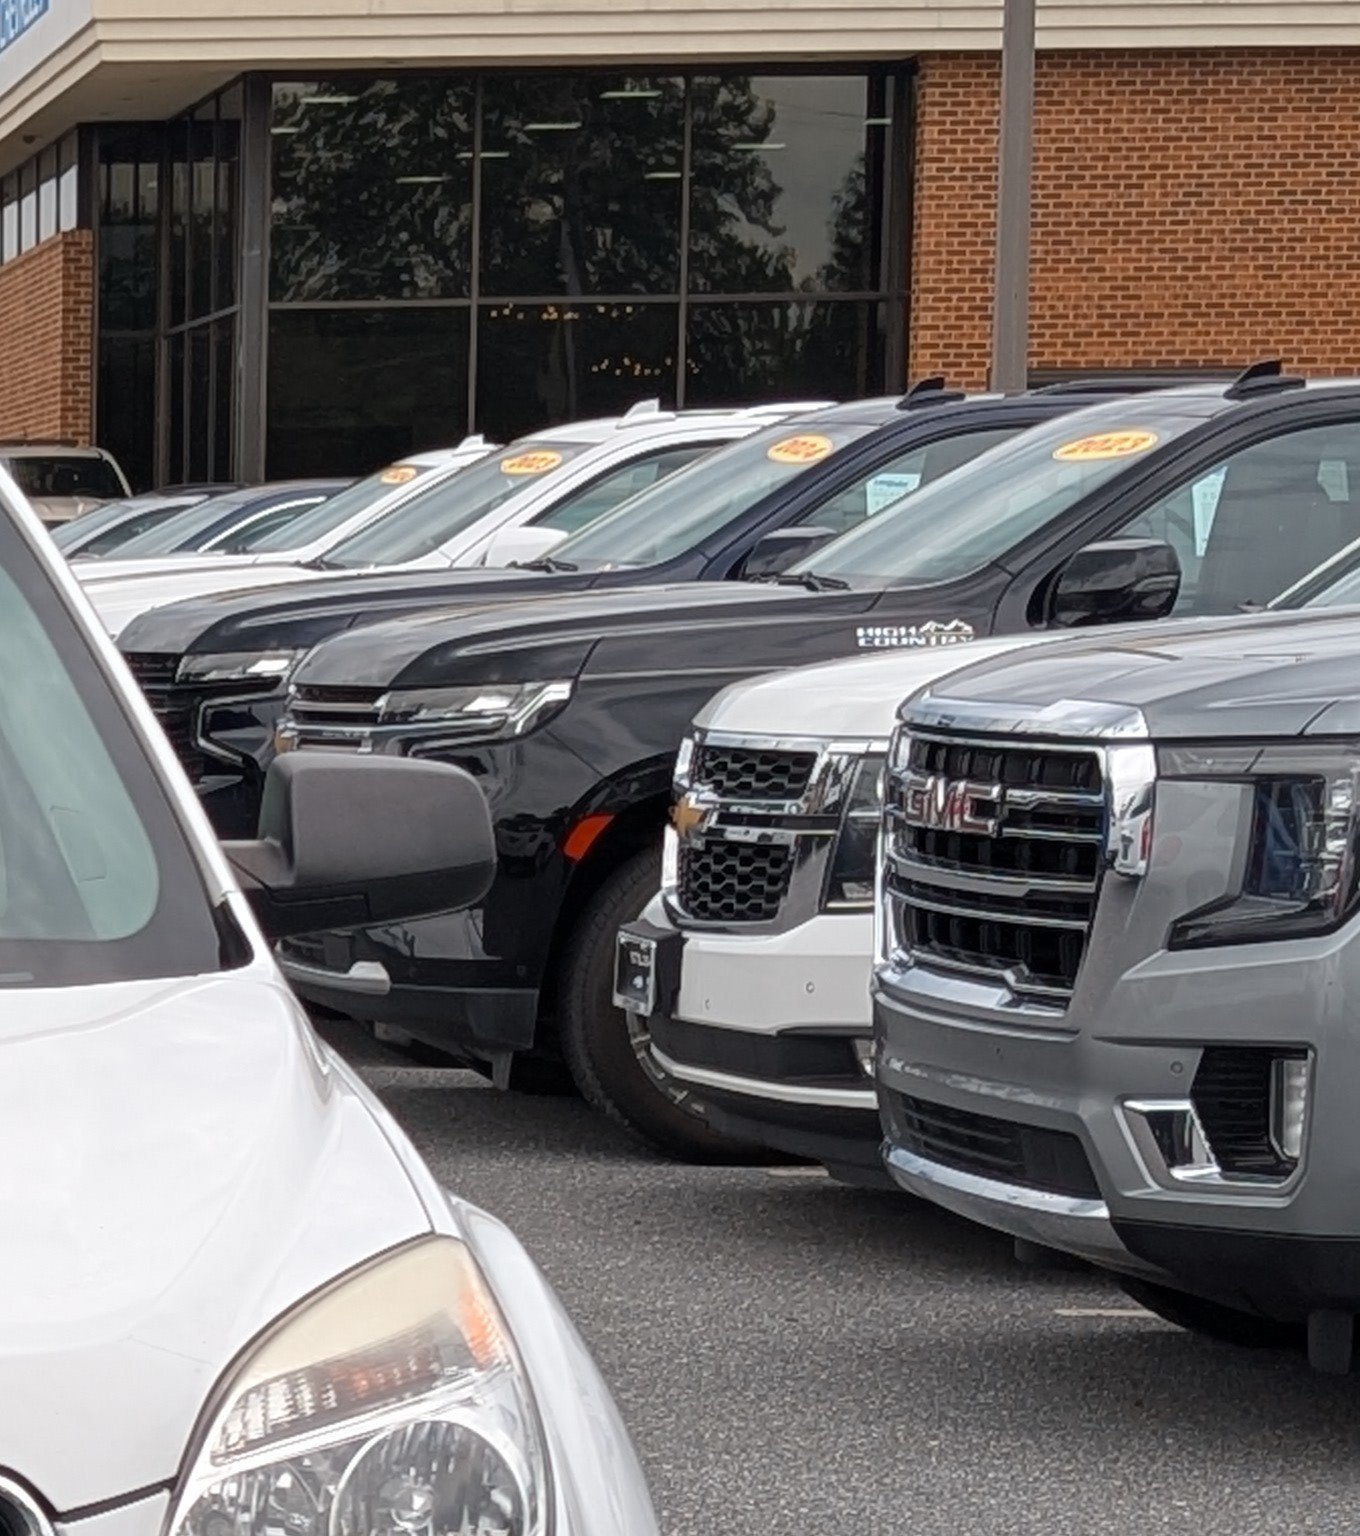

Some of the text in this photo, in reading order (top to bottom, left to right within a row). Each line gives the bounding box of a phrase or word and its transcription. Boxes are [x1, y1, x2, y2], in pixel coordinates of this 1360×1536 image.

[1062, 436, 1152, 456] 2023
[856, 626, 917, 637] HIGH
[902, 776, 1001, 838] GMC
